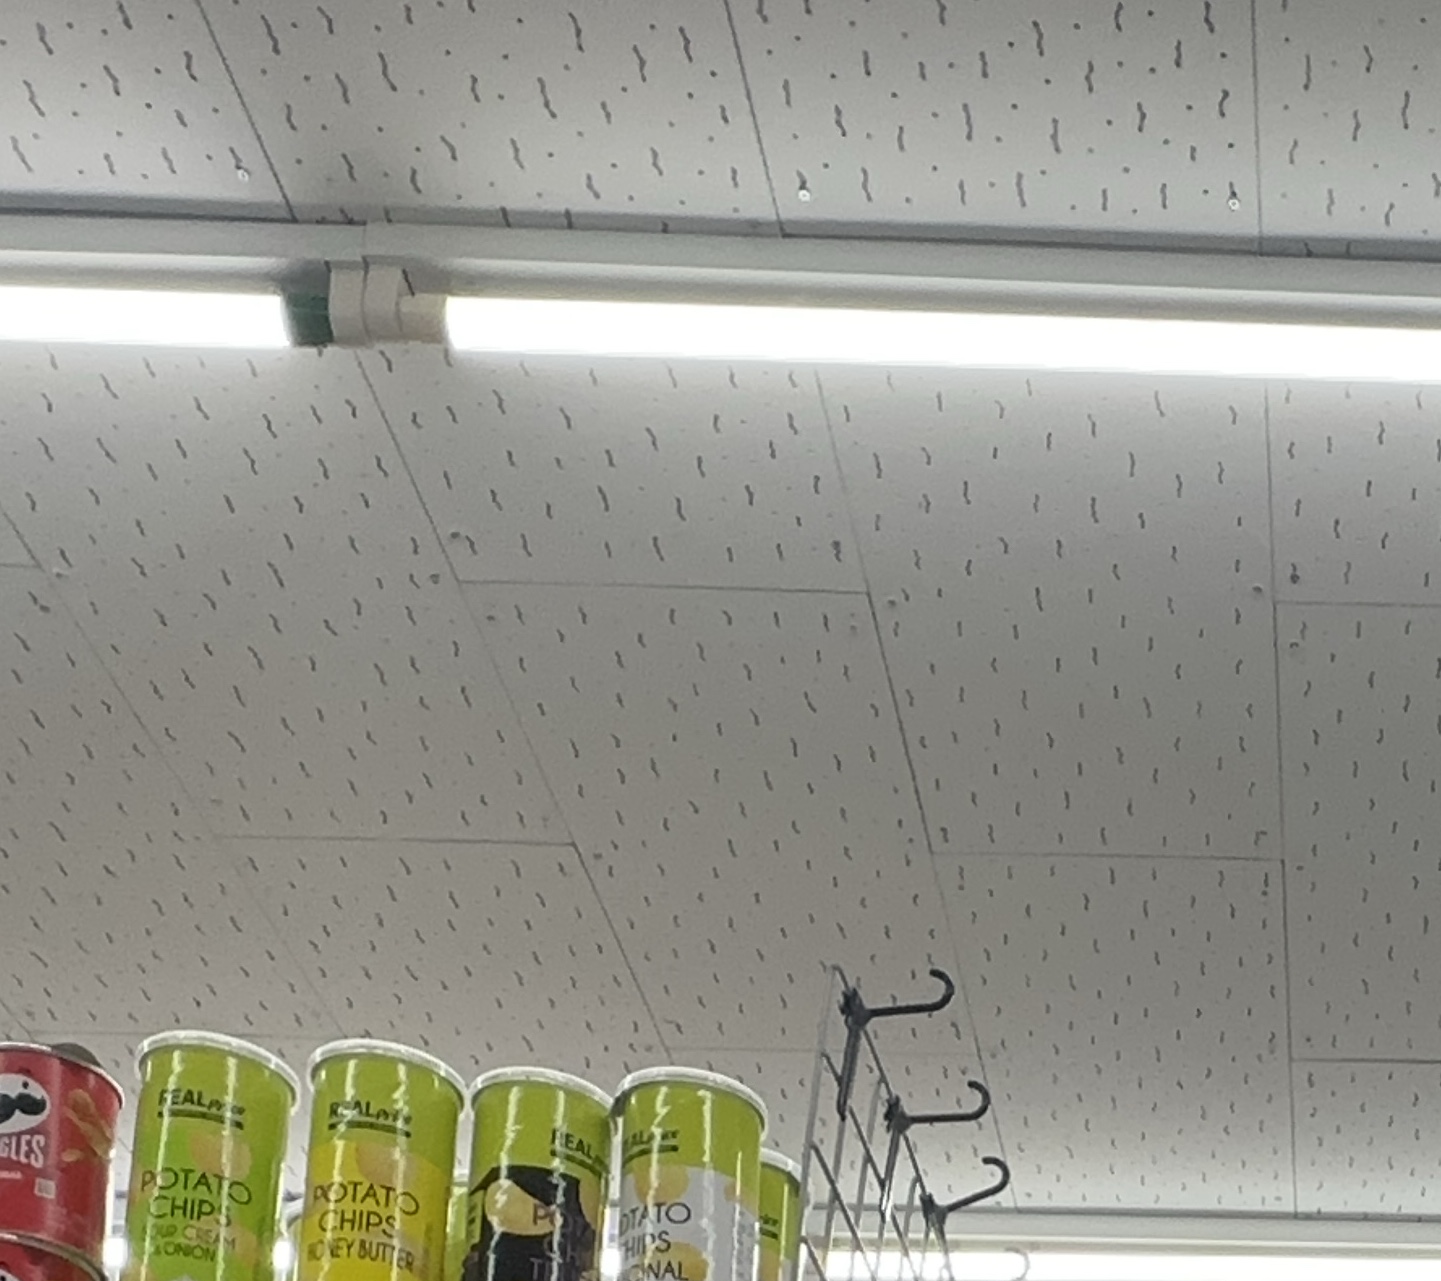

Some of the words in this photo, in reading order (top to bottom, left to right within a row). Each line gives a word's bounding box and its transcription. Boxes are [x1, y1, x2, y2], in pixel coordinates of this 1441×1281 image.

[141, 1167, 252, 1206] POTATO
[313, 1180, 420, 1217] POTATO
[149, 1194, 232, 1227] CHIPS
[318, 1208, 399, 1239] CHIPS
[620, 1202, 692, 1233] OTATO
